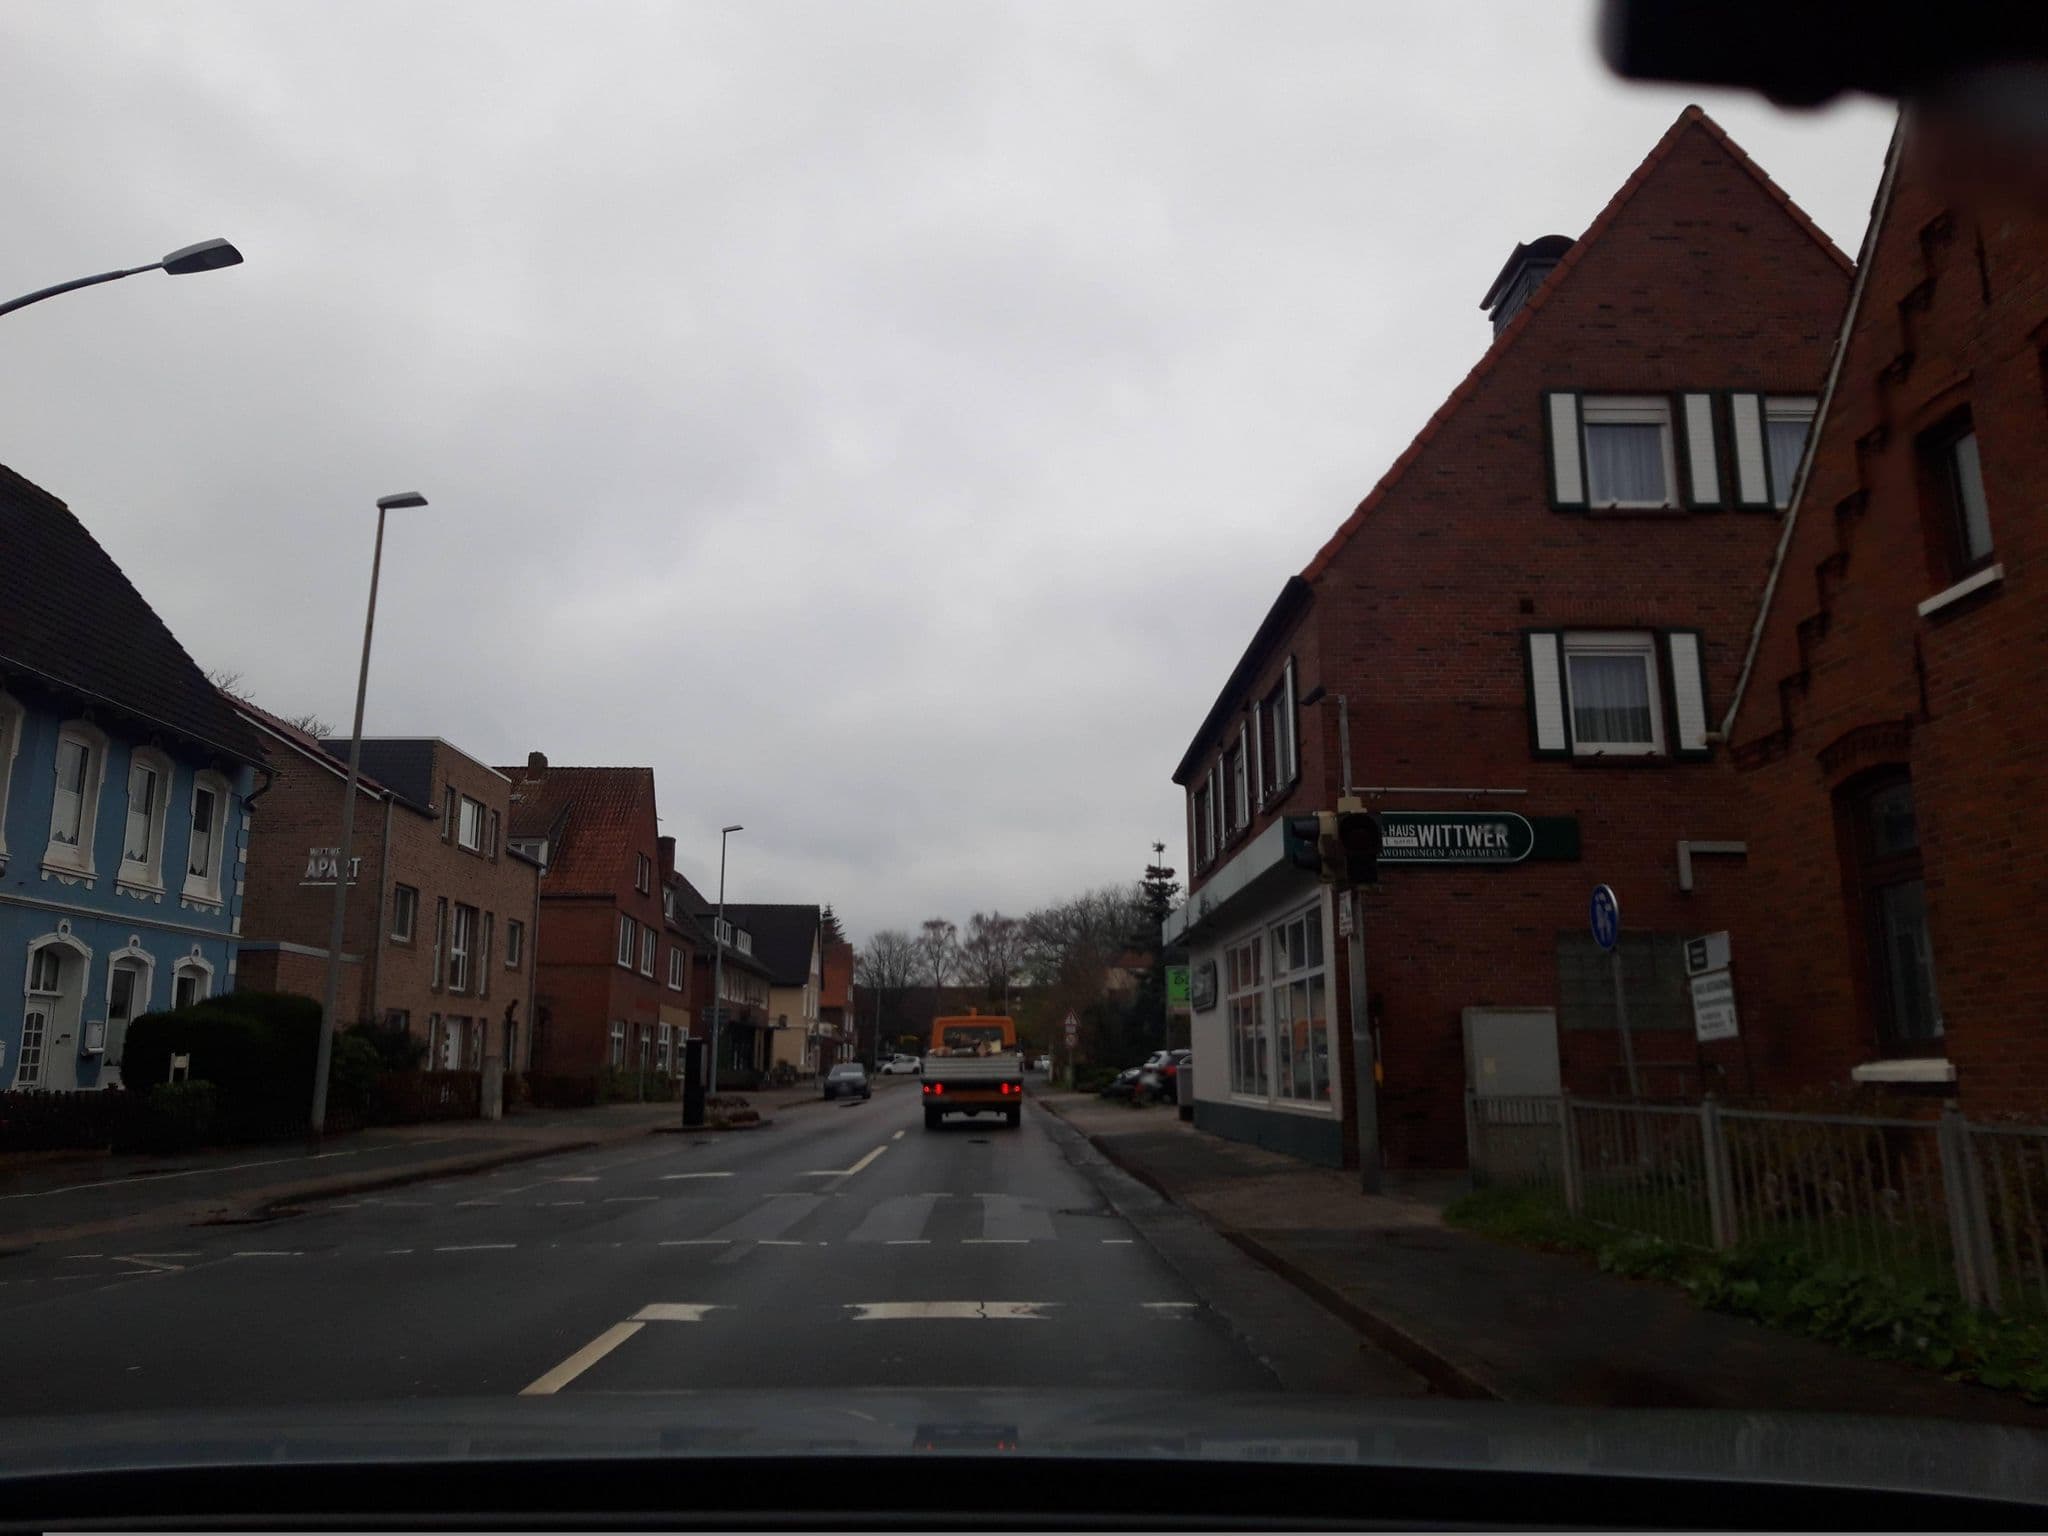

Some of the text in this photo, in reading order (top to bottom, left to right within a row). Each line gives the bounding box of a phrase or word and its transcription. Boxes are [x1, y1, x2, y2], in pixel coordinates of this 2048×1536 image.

[1388, 824, 1416, 837] HAUS
[1417, 824, 1509, 848] WITTWER
[1380, 848, 1445, 857] WOHNUNGEN
